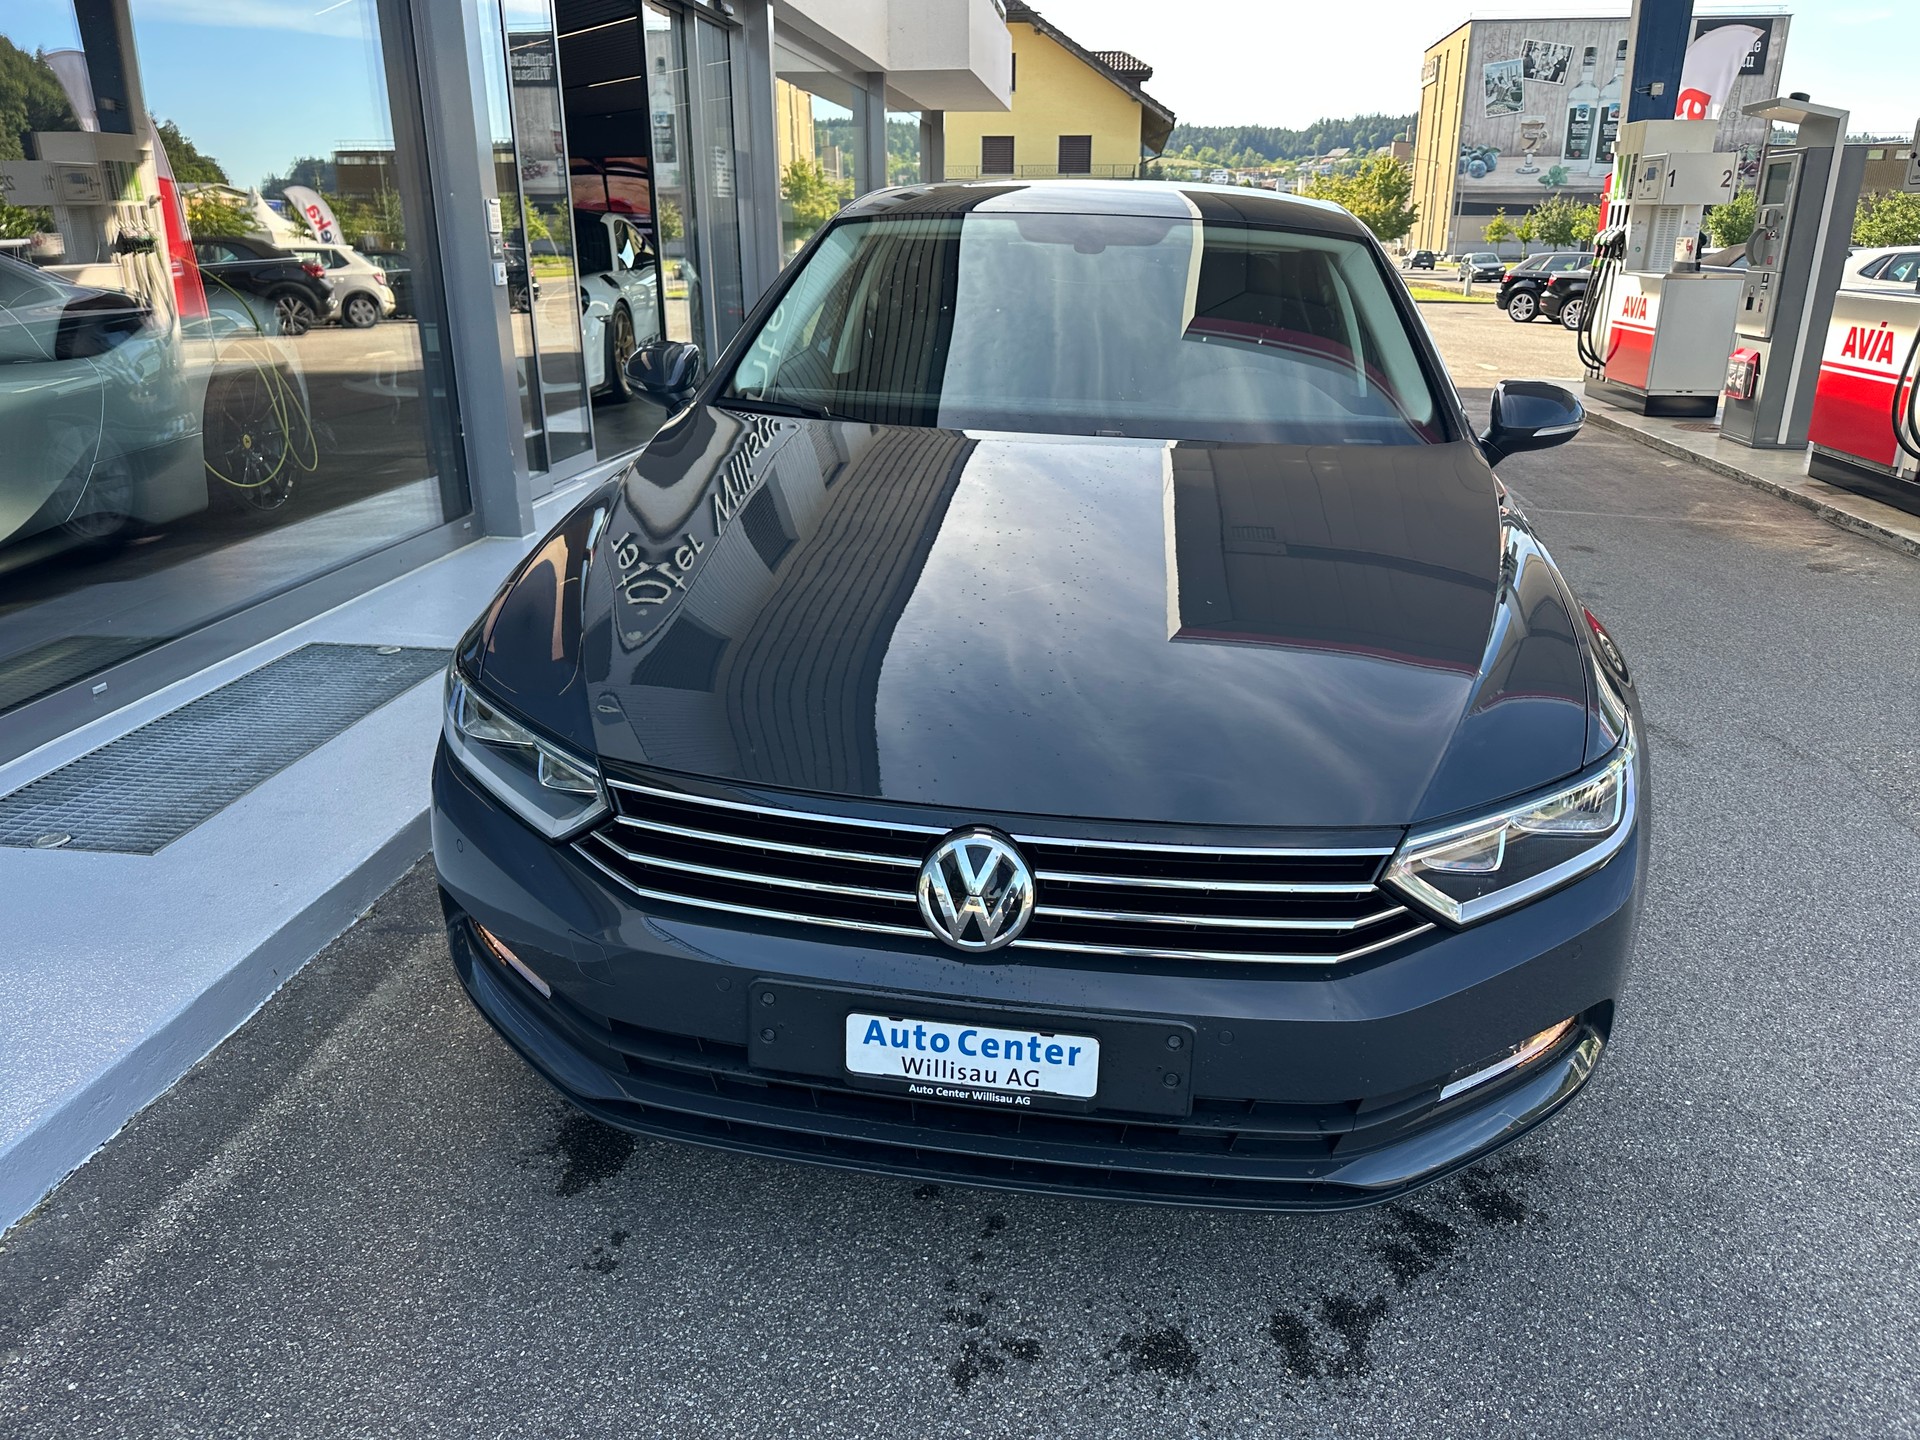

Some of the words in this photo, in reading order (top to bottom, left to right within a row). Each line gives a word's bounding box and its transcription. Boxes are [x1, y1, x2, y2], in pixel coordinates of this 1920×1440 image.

[1668, 169, 1676, 187] 1
[1720, 169, 1732, 188] 2
[863, 1019, 951, 1053] Auto
[958, 1030, 1081, 1067] Center
[901, 1056, 997, 1084] Willisau
[1006, 1068, 1040, 1088] AG
[908, 1084, 934, 1096] Auto
[936, 1087, 970, 1100] Center
[972, 1090, 1013, 1104] Willisau
[1015, 1095, 1031, 1106] AG
